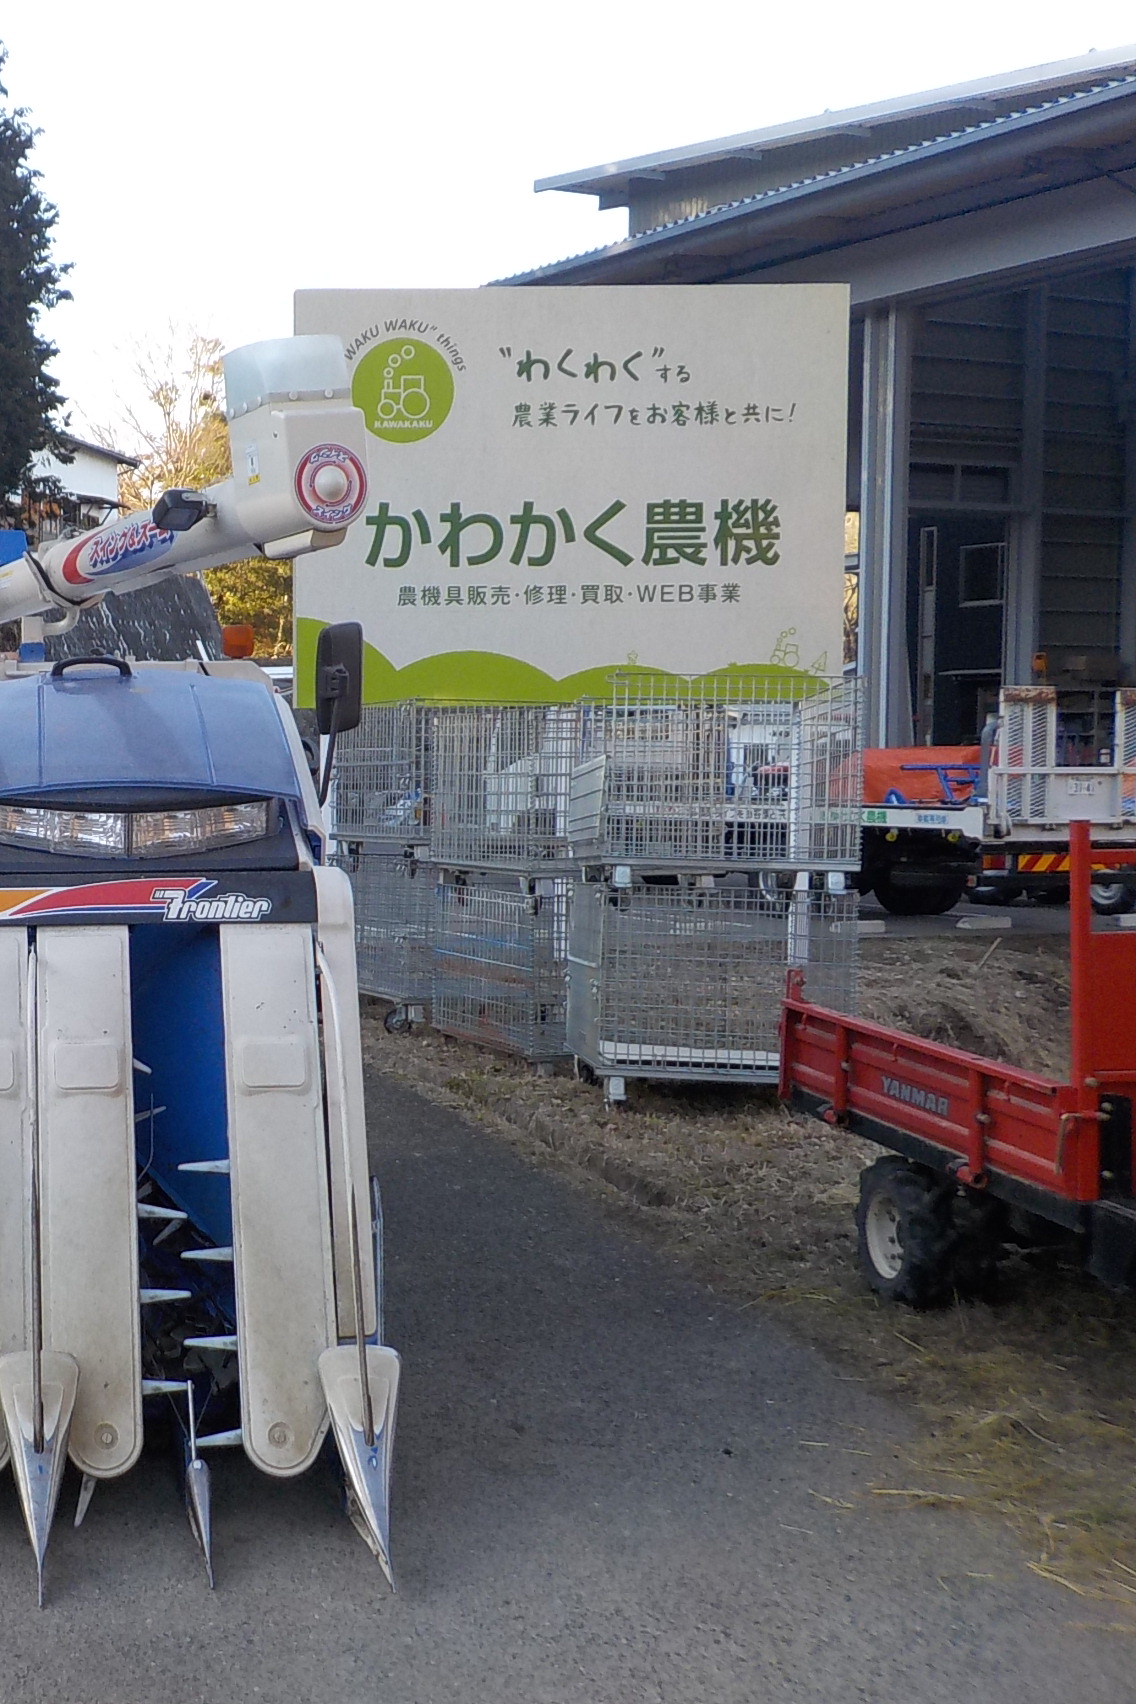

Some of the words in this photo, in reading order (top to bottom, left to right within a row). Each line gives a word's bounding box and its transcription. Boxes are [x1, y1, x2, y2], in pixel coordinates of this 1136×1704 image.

[344, 325, 380, 361] WAKU
[436, 333, 467, 372] things
[374, 420, 433, 429] KAWAKAKU
[512, 400, 797, 428] 農業ライフをお客様と共に!
[364, 497, 782, 568] かわかく農機
[396, 583, 742, 607] 農機具販売・修理・買取・WEB事業
[151, 888, 272, 921] Frontier
[881, 1075, 949, 1117] YANMAR
